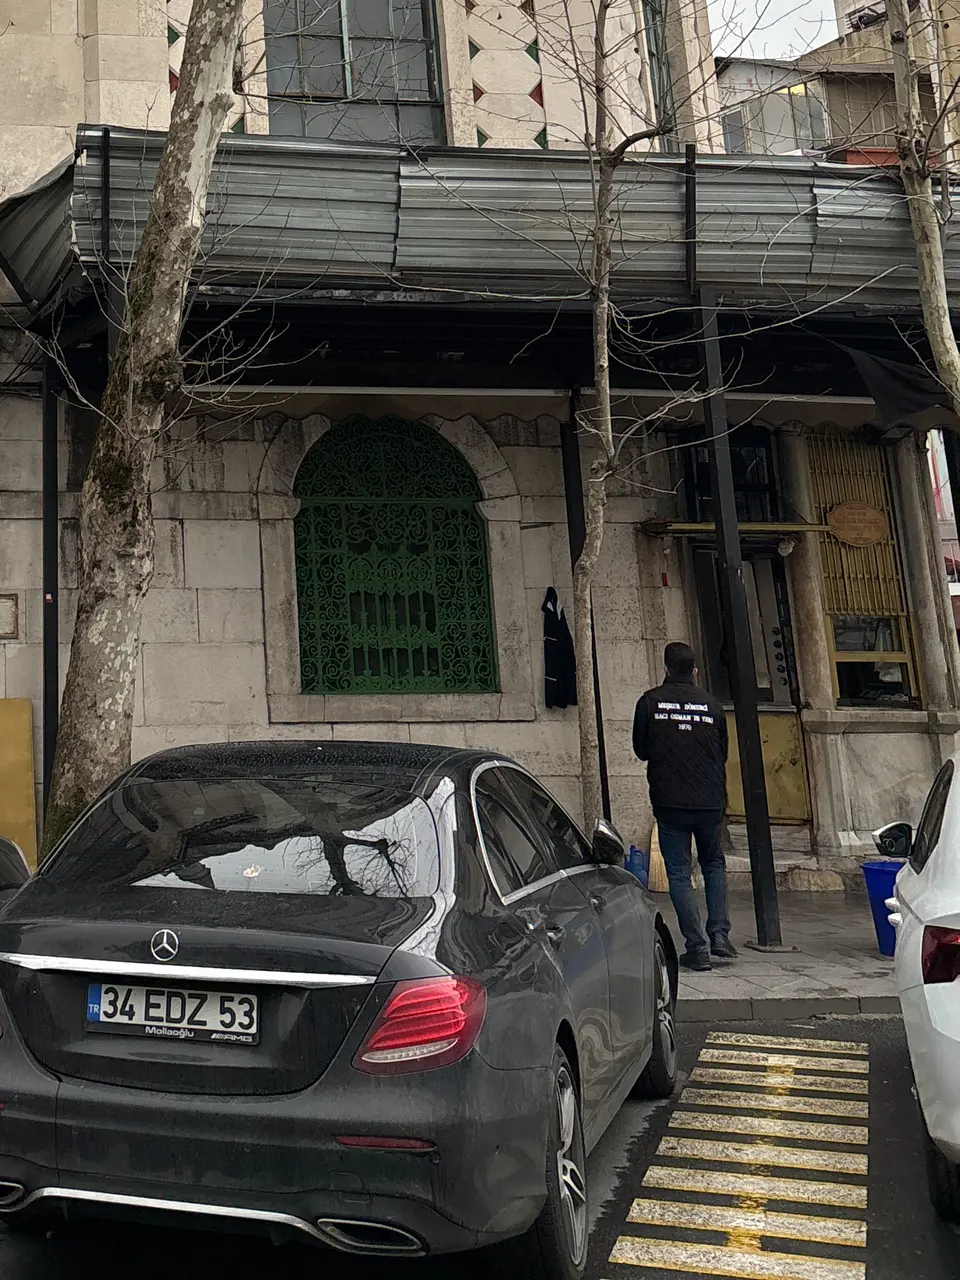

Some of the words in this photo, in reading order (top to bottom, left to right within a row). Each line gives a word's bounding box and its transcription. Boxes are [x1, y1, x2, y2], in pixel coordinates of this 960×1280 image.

[89, 1004, 99, 1014] TR
[103, 986, 136, 1020] 34
[145, 989, 208, 1026] EDZ
[219, 995, 255, 1030] 53
[145, 1026, 194, 1039] Mollaoğlu
